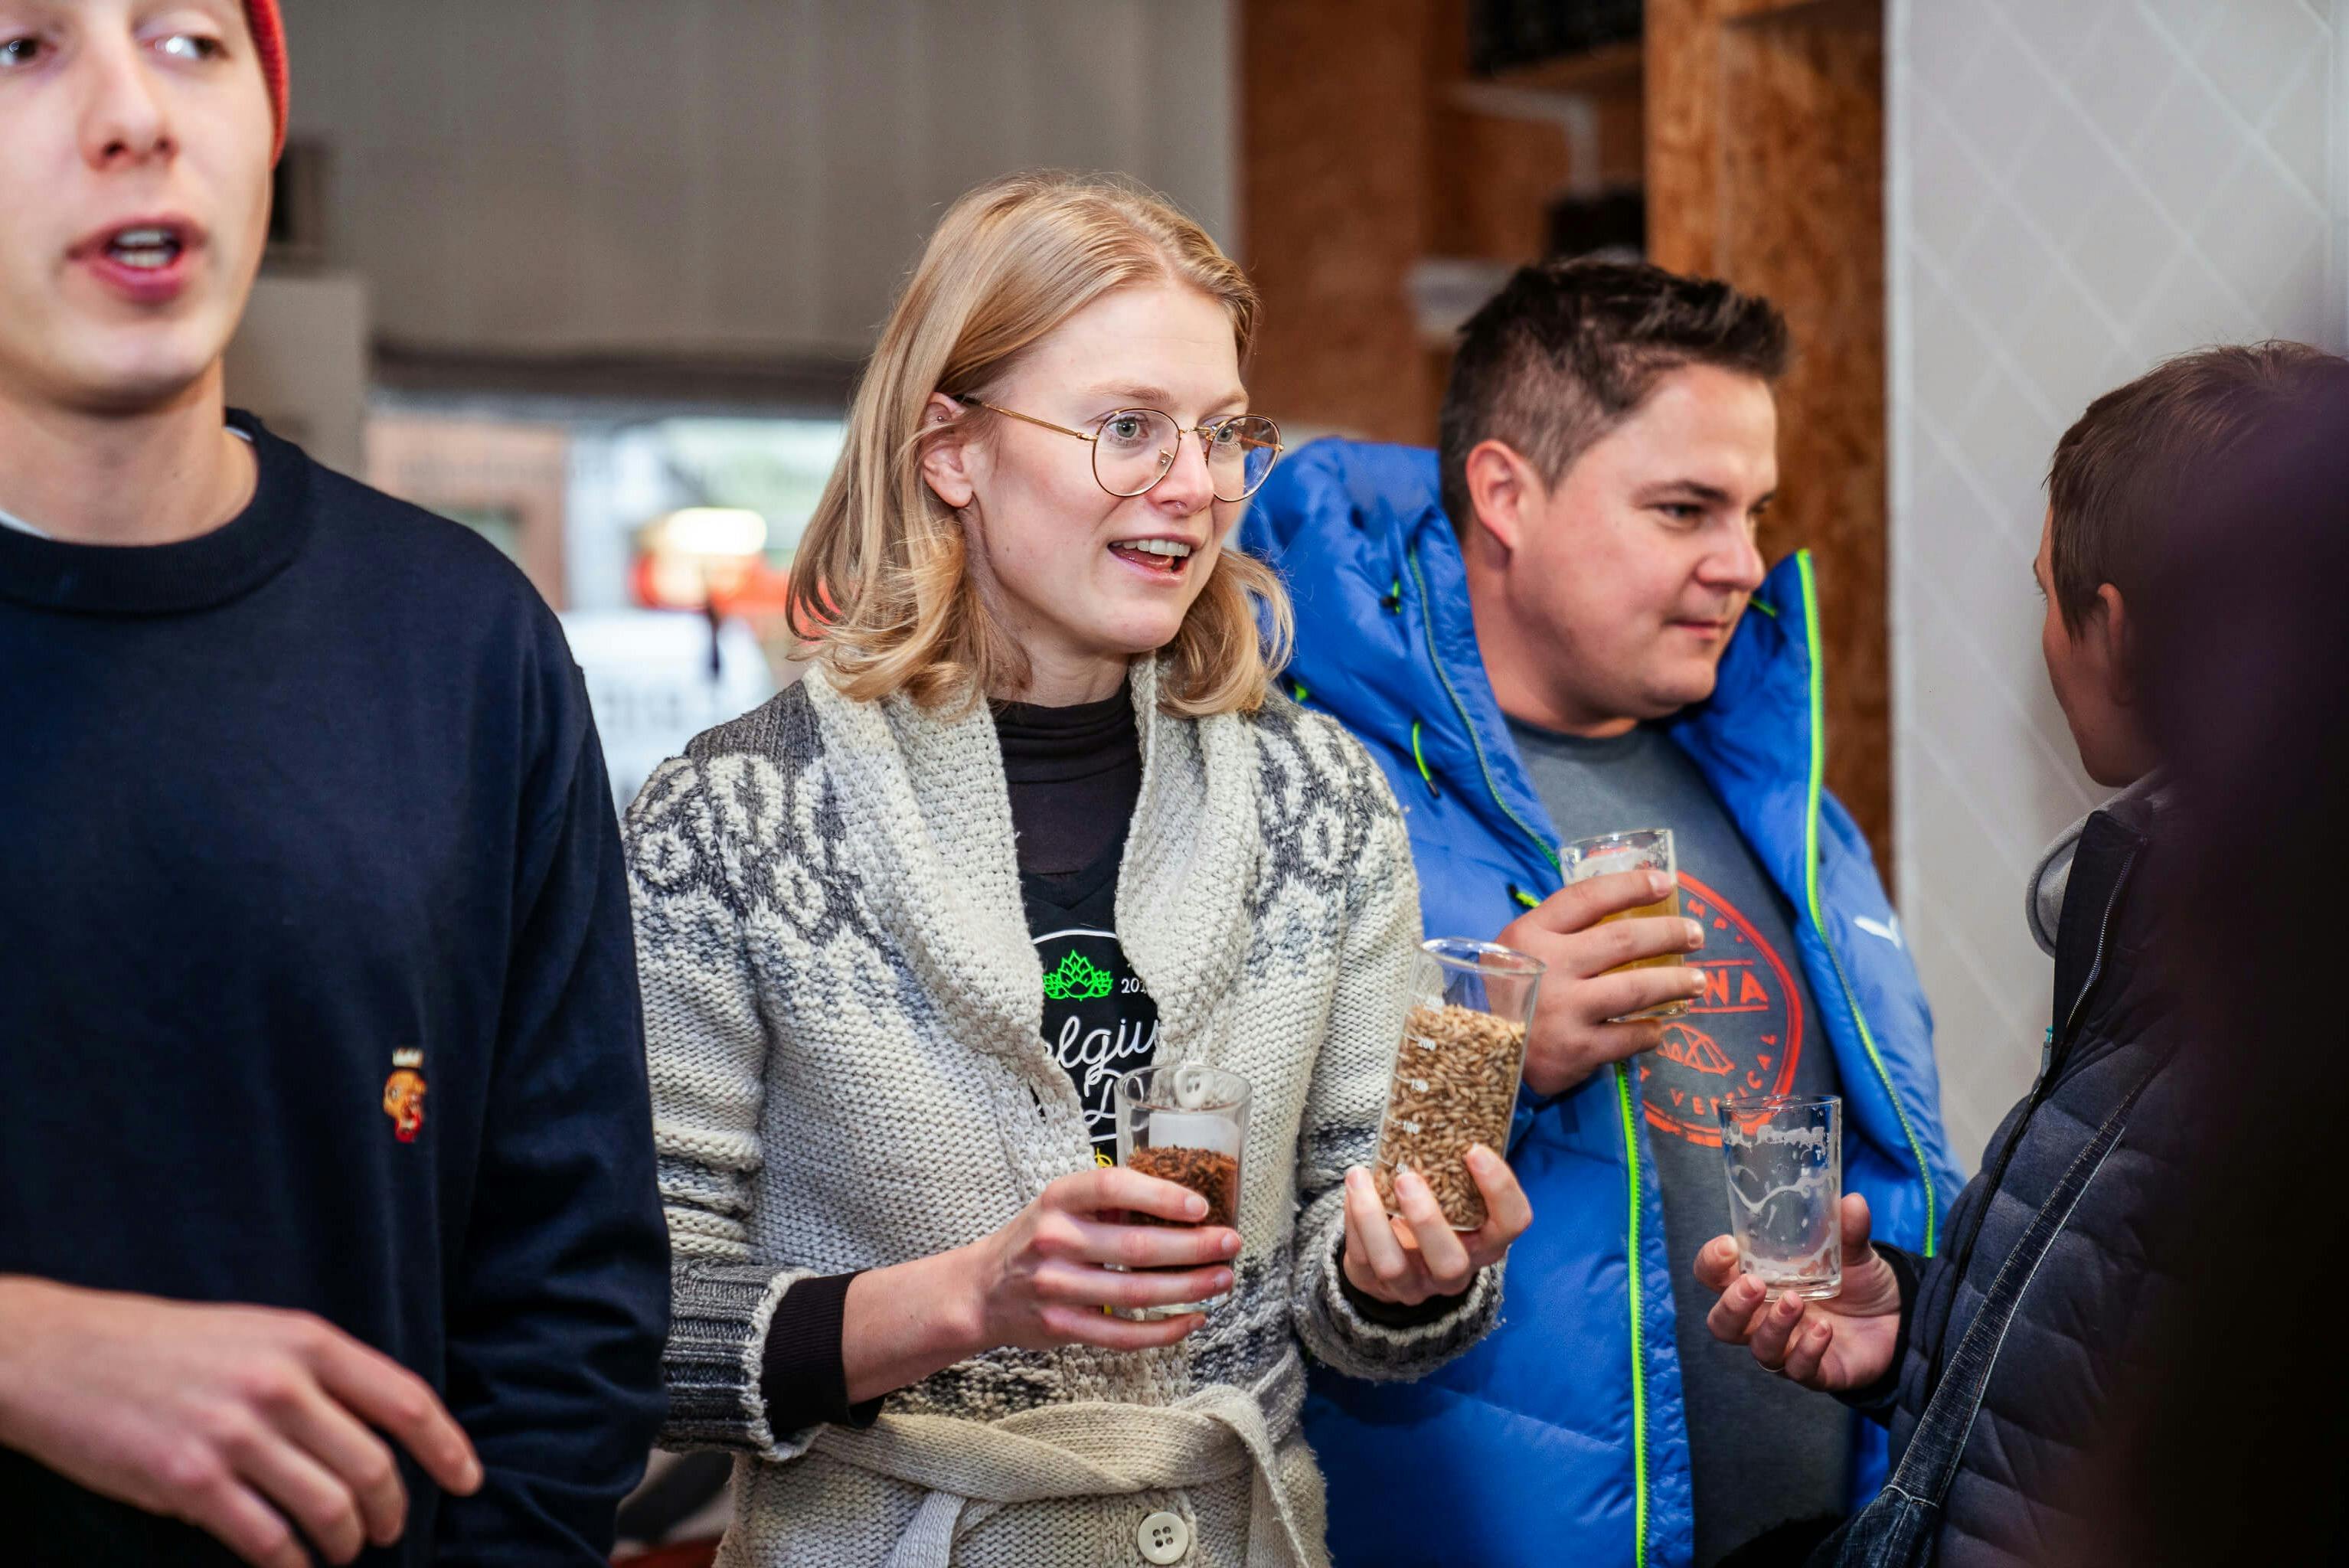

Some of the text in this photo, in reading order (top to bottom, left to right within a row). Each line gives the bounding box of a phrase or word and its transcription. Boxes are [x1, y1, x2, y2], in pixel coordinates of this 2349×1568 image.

[1121, 978, 1147, 994] 201
[1700, 968, 1770, 1006] NA
[1403, 1120, 1420, 1135] 100
